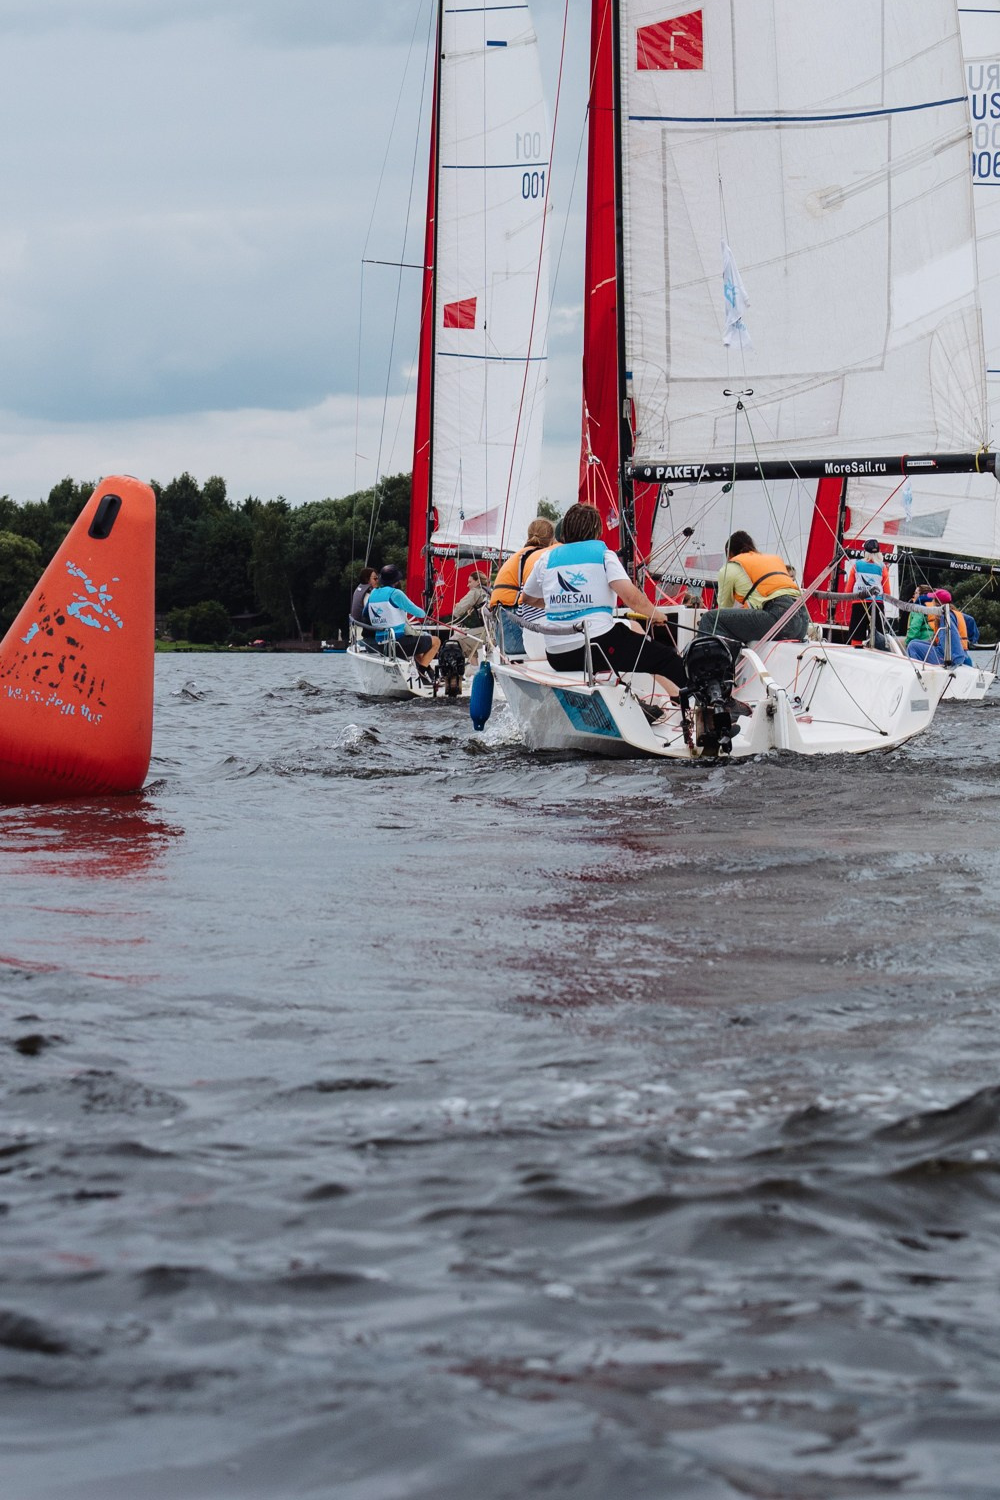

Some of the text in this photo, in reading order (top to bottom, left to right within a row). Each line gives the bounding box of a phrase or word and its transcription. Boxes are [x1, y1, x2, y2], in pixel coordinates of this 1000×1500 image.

[522, 170, 545, 199] 001
[825, 462, 887, 474] MoreSail.ru
[950, 561, 982, 572] MoreSail.ru
[692, 579, 706, 587] 670
[406, 676, 422, 689] 11
